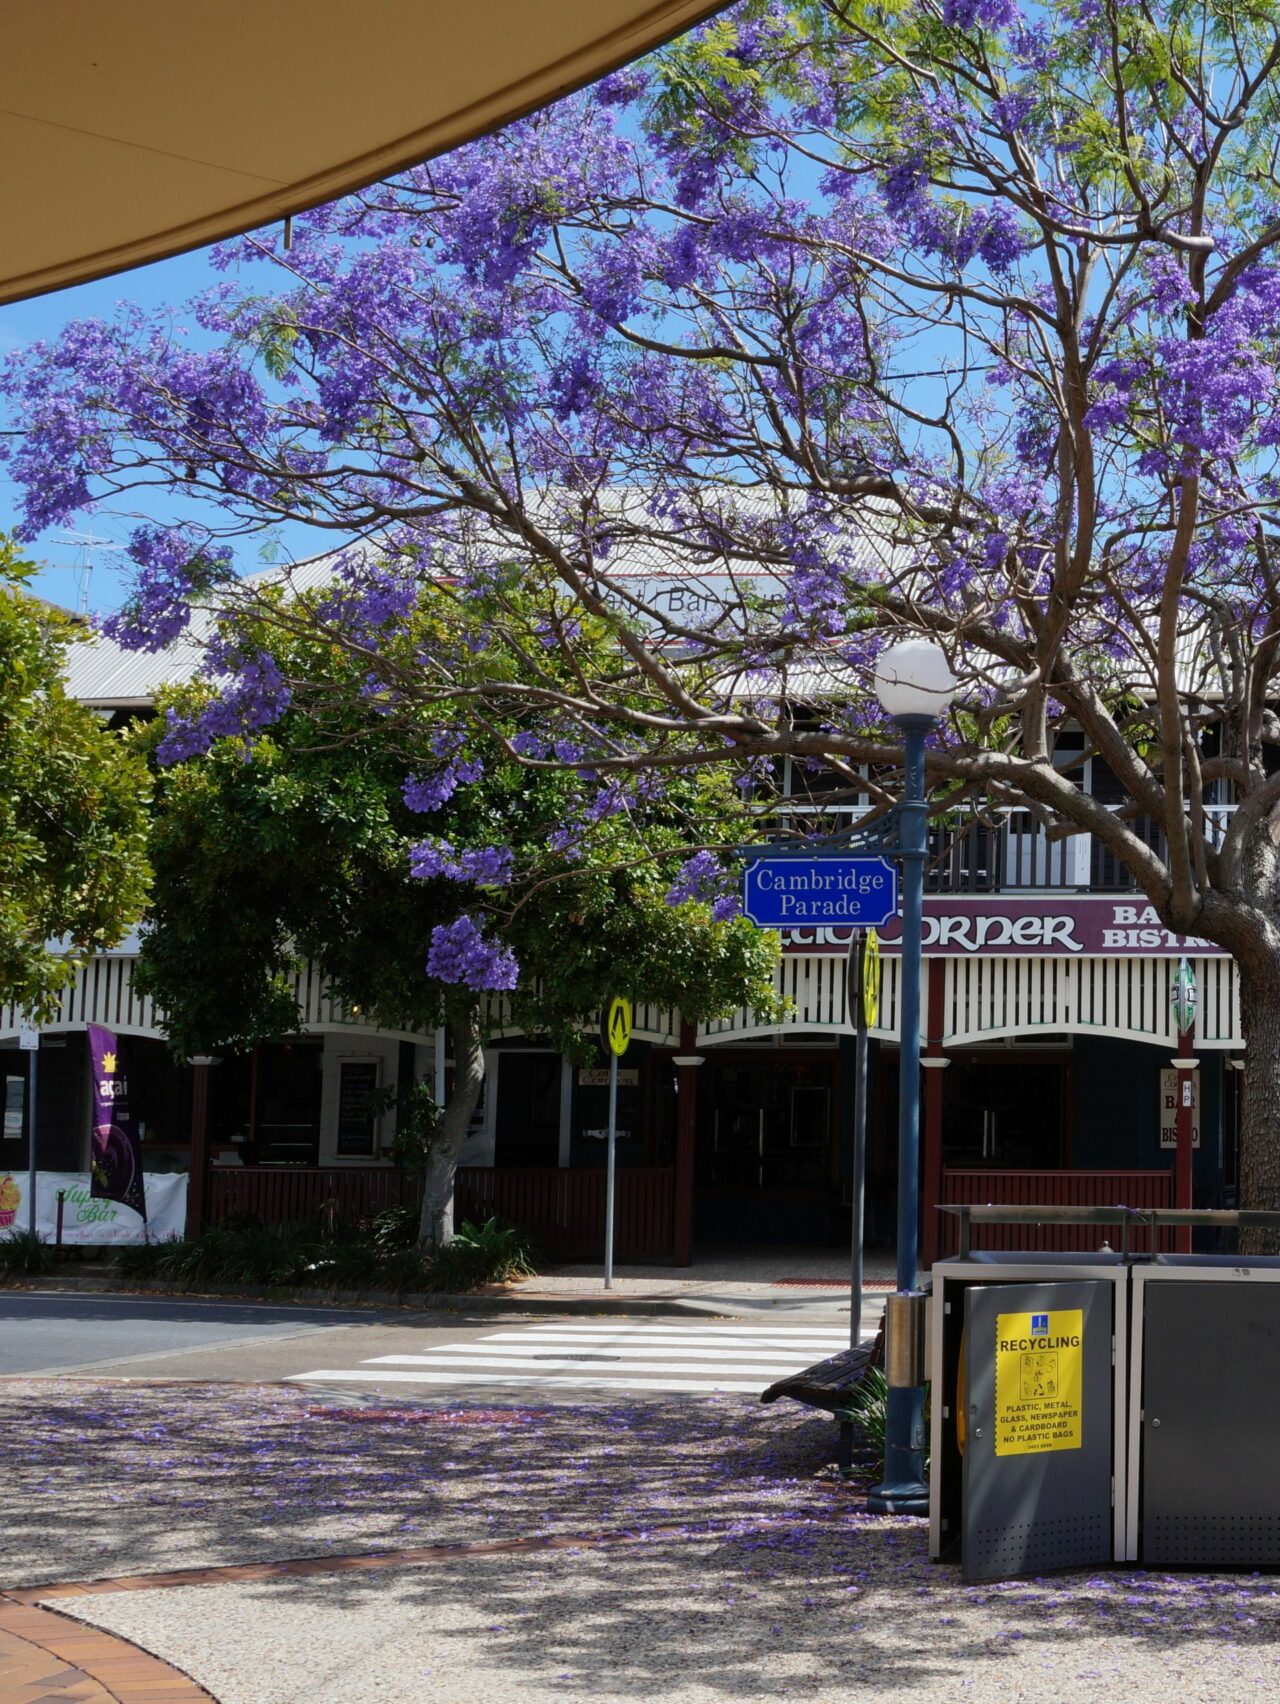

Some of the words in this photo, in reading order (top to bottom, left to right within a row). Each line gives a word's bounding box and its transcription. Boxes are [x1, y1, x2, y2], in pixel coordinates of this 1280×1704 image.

[757, 868, 884, 894] Cambridge
[780, 895, 861, 915] Parade
[1112, 906, 1162, 925] BA
[100, 1074, 128, 1100] açaí
[1161, 1127, 1199, 1142] BISO
[76, 1203, 119, 1223] Bar
[1000, 1335, 1080, 1352] RECYCLING
[1006, 1403, 1042, 1413] PLASTIC,
[1043, 1401, 1072, 1409] METAL,
[1000, 1414, 1028, 1424] GLASS,
[1030, 1410, 1078, 1421] NEWSPAPER
[1011, 1425, 1017, 1433] &
[1019, 1421, 1068, 1432] CARDBOARD
[1003, 1435, 1015, 1443] NO
[1017, 1433, 1050, 1442] PLASTIC
[1052, 1430, 1074, 1439] BAGS
